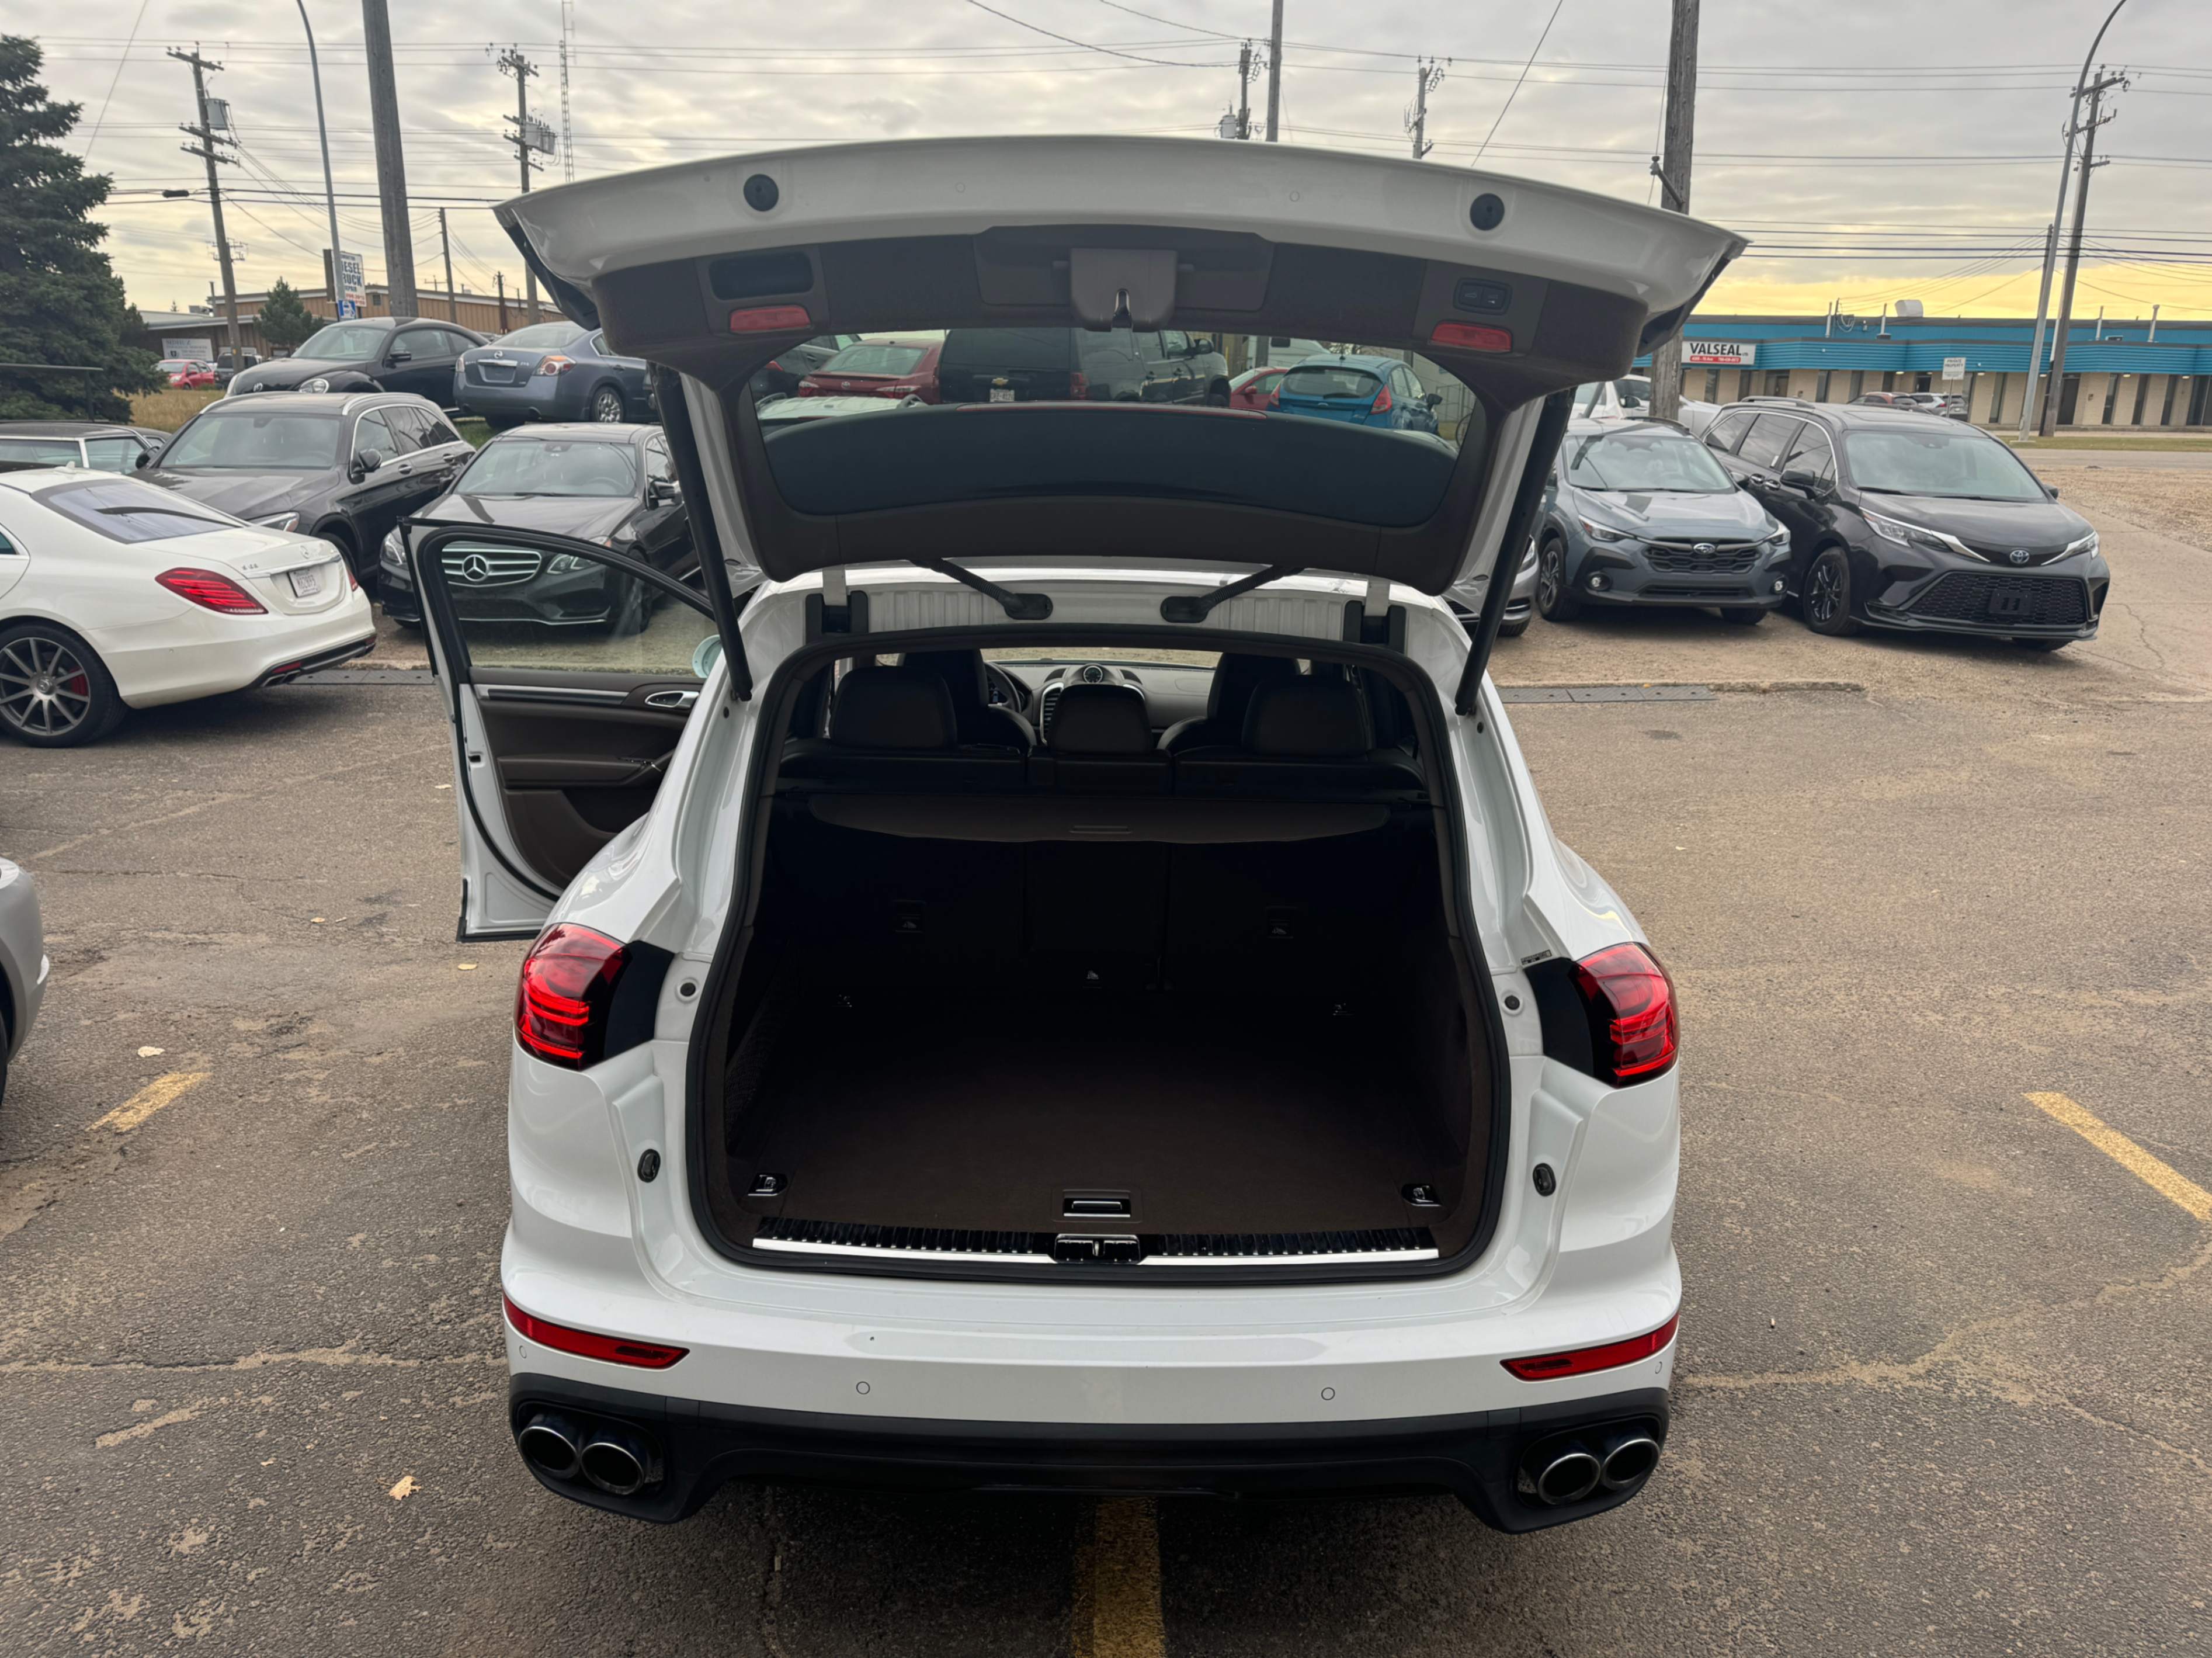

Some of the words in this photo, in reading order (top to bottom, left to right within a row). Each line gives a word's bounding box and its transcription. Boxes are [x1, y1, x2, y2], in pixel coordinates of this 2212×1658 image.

[342, 261, 361, 275] IESEL
[343, 273, 362, 287] RUCK
[1690, 343, 1741, 356] VALSEAL
